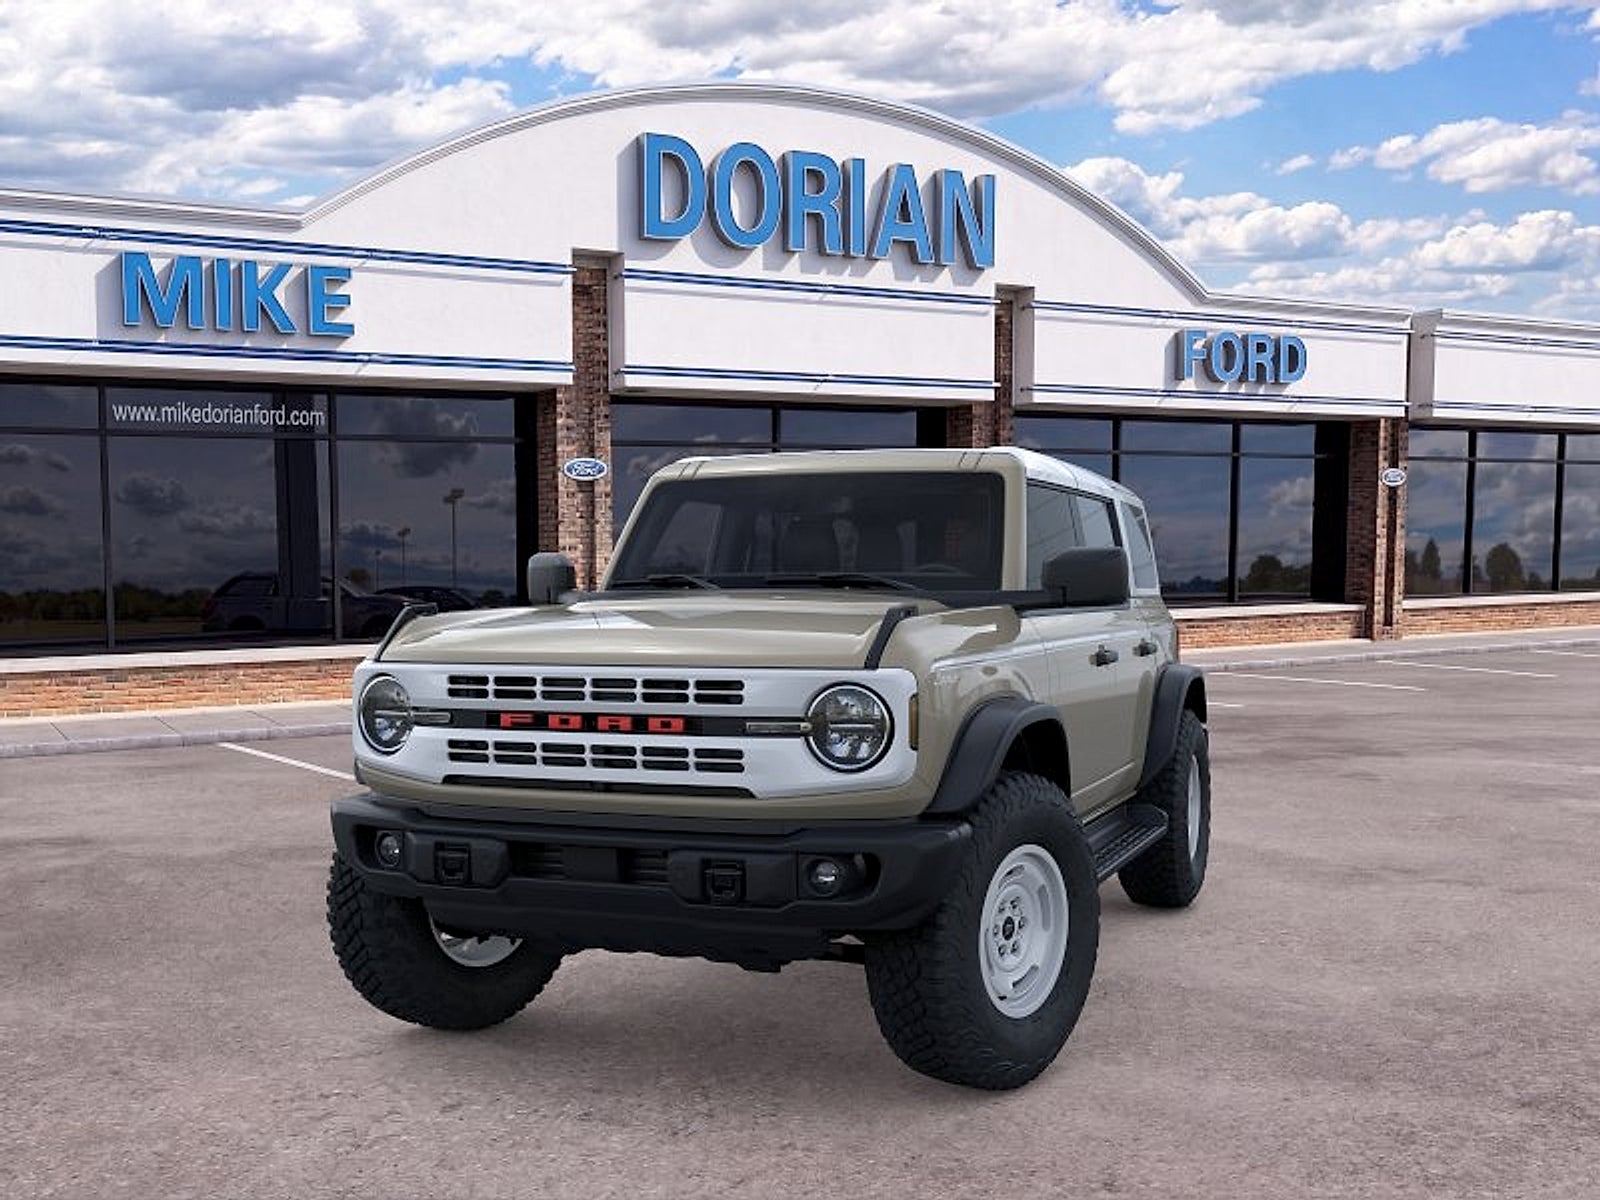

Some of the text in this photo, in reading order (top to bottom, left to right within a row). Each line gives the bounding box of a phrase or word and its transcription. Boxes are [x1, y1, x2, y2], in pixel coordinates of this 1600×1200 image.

[641, 132, 996, 269] DORIAN
[122, 251, 355, 336] MIKE
[1180, 328, 1308, 383] FORD
[112, 402, 325, 426] www.mikedorianford.com
[571, 462, 602, 475] Ford
[500, 712, 686, 733] FORD
